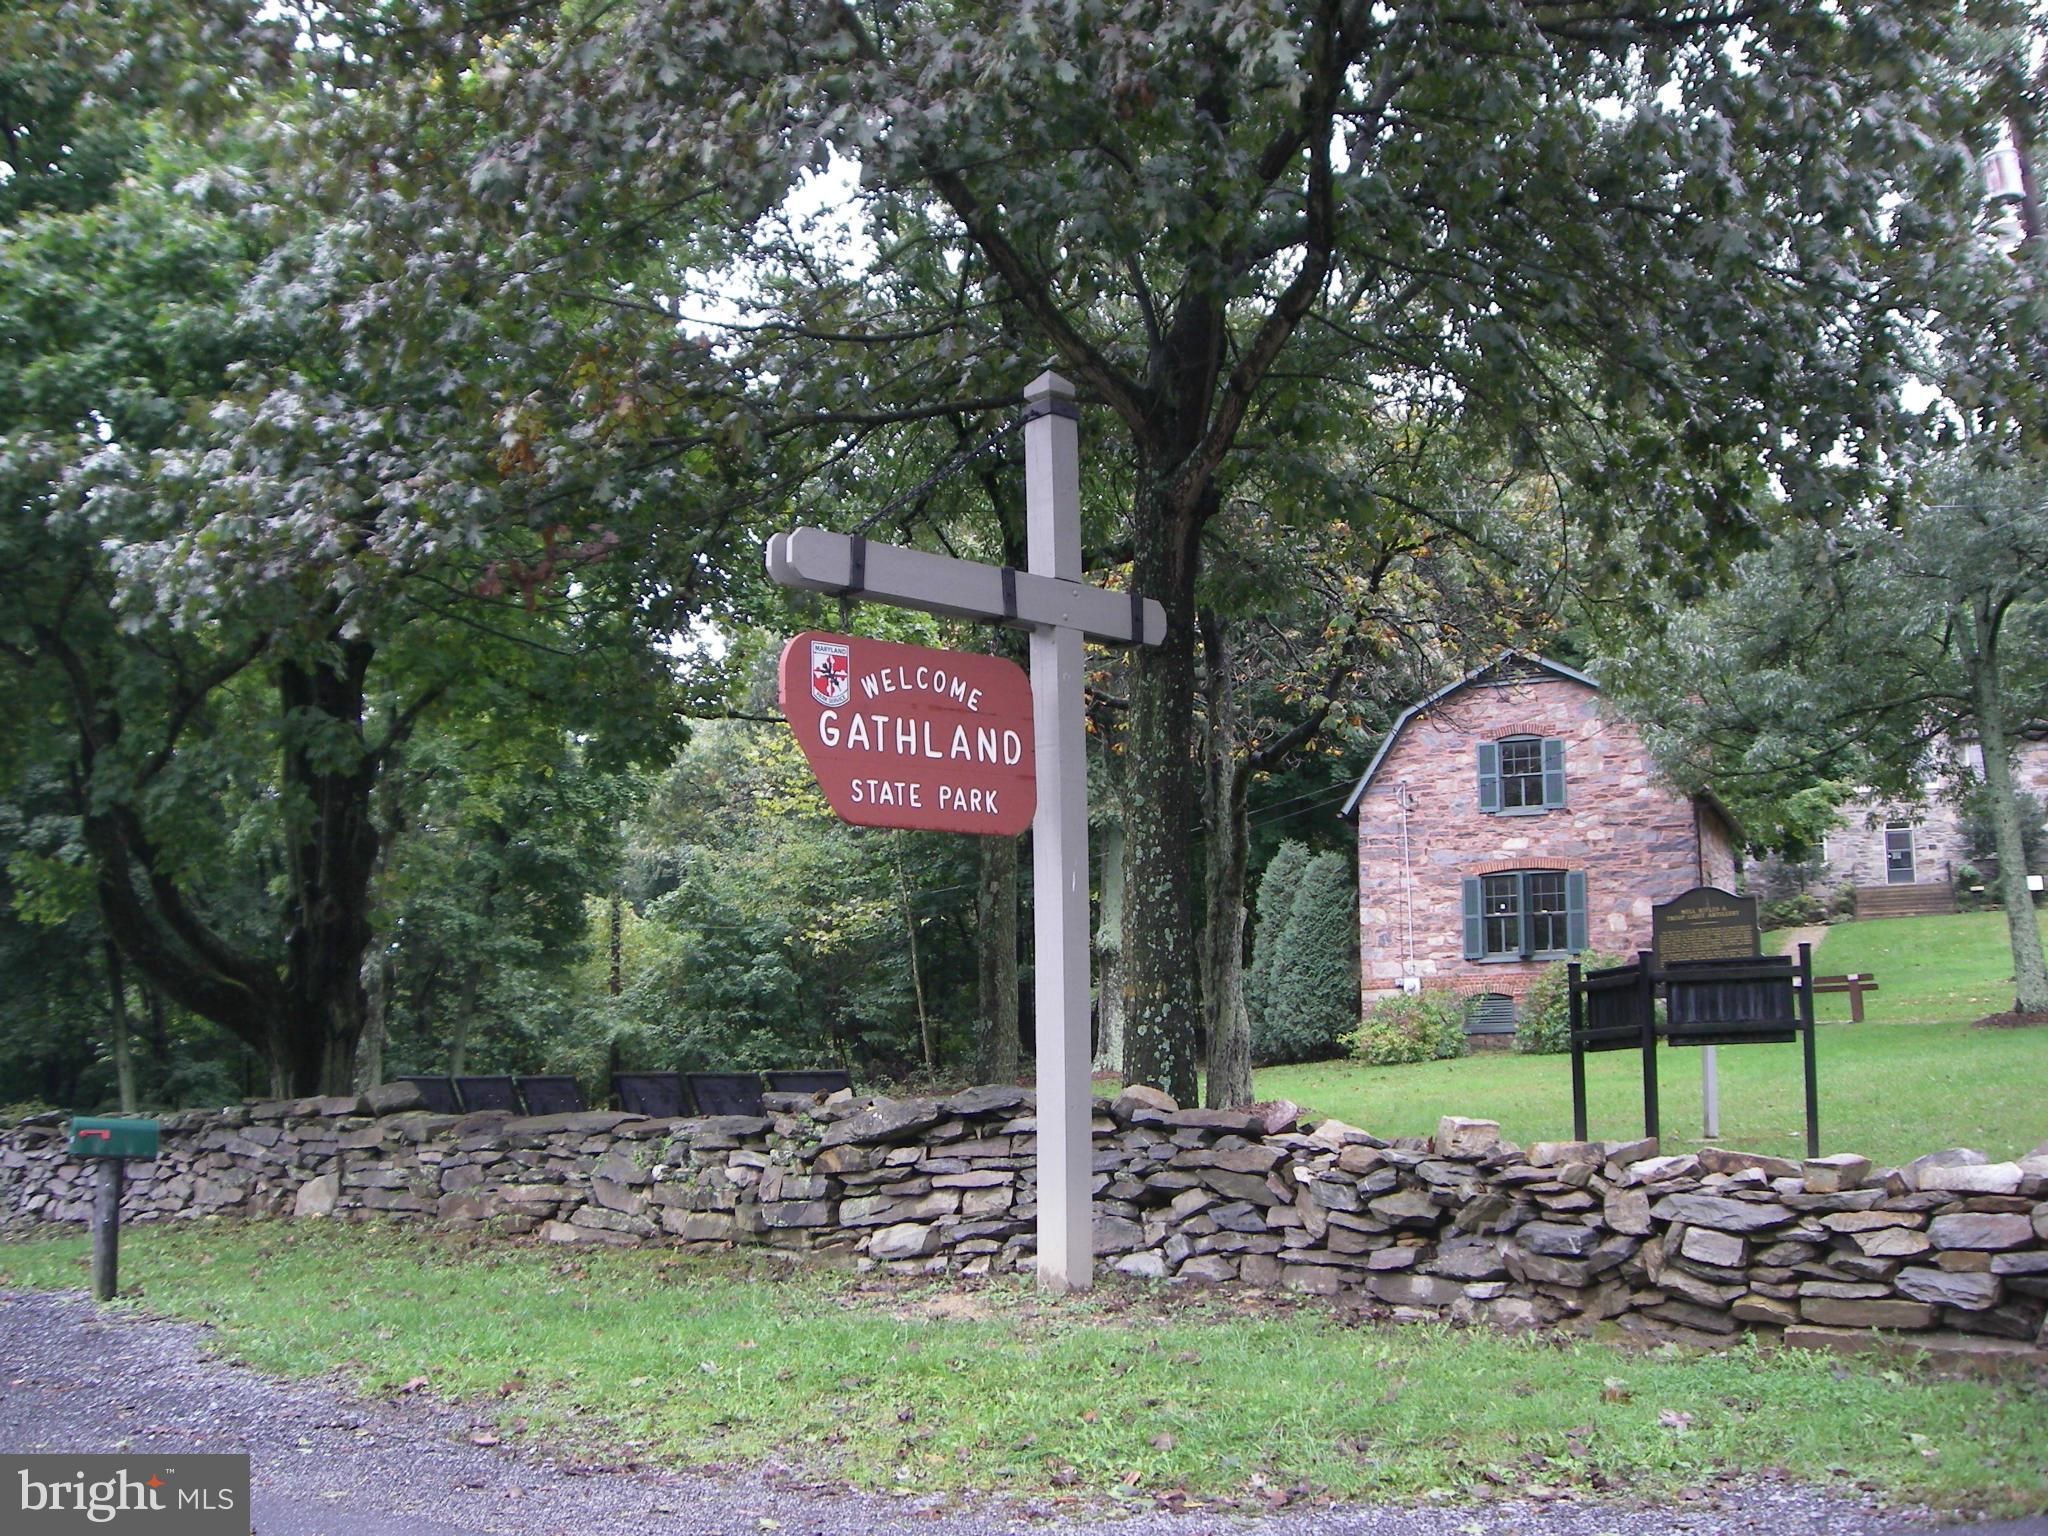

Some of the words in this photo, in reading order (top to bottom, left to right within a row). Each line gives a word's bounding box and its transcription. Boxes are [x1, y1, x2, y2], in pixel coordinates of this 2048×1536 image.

[814, 645, 846, 655] MARYLAND
[860, 666, 983, 712] WELCOME
[819, 709, 1022, 766] GATHLAND
[851, 779, 922, 808] STATE
[939, 785, 999, 815] PARK
